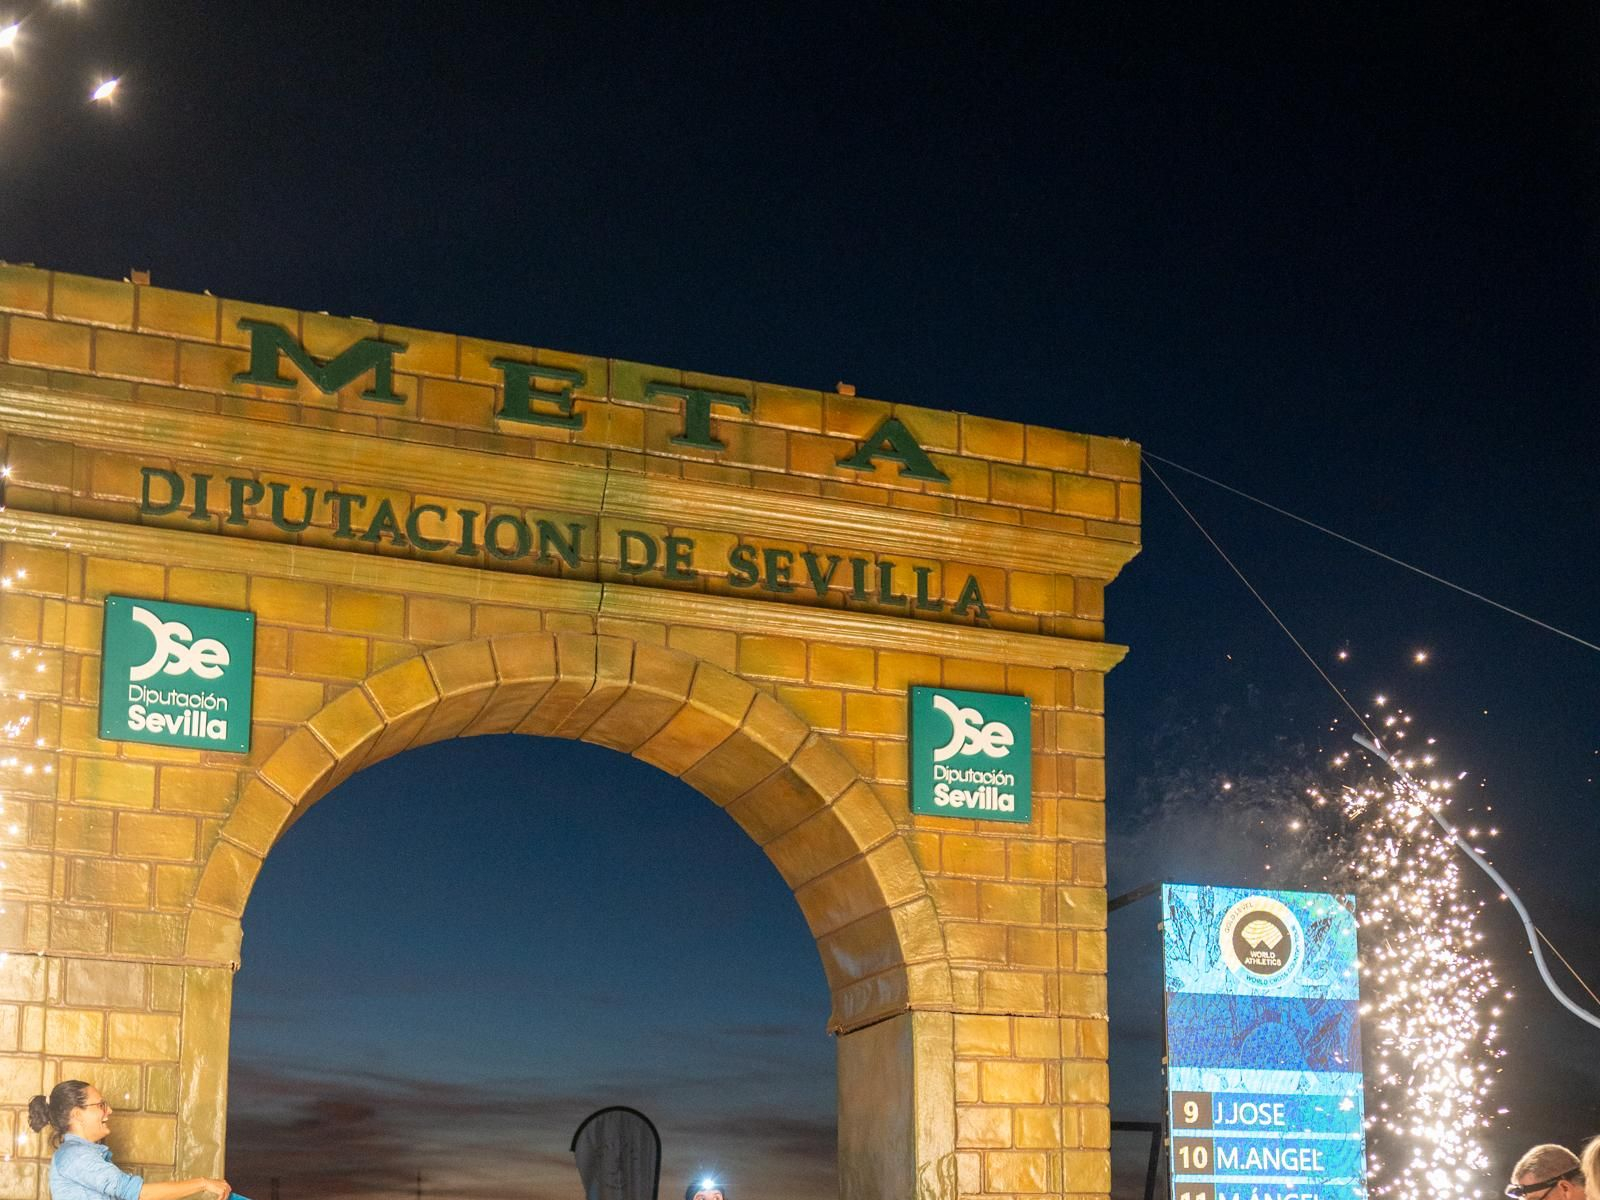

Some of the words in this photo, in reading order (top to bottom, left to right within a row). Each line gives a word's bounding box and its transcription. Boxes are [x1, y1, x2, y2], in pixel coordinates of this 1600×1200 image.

[231, 317, 950, 484] META
[139, 467, 587, 568] DIPUTACION
[617, 529, 698, 581] DE
[727, 544, 991, 619] SEVILLA
[128, 684, 228, 712] Diputación
[127, 704, 228, 740] Sevilla
[933, 764, 1015, 787] Diputación
[933, 782, 1015, 812] Sevilla
[1250, 950, 1275, 959] WORLD
[1183, 1101, 1199, 1124] 9
[1214, 1102, 1285, 1126] J.JOSE
[1179, 1146, 1208, 1169] 10
[1217, 1146, 1325, 1171] M.ANGEL
